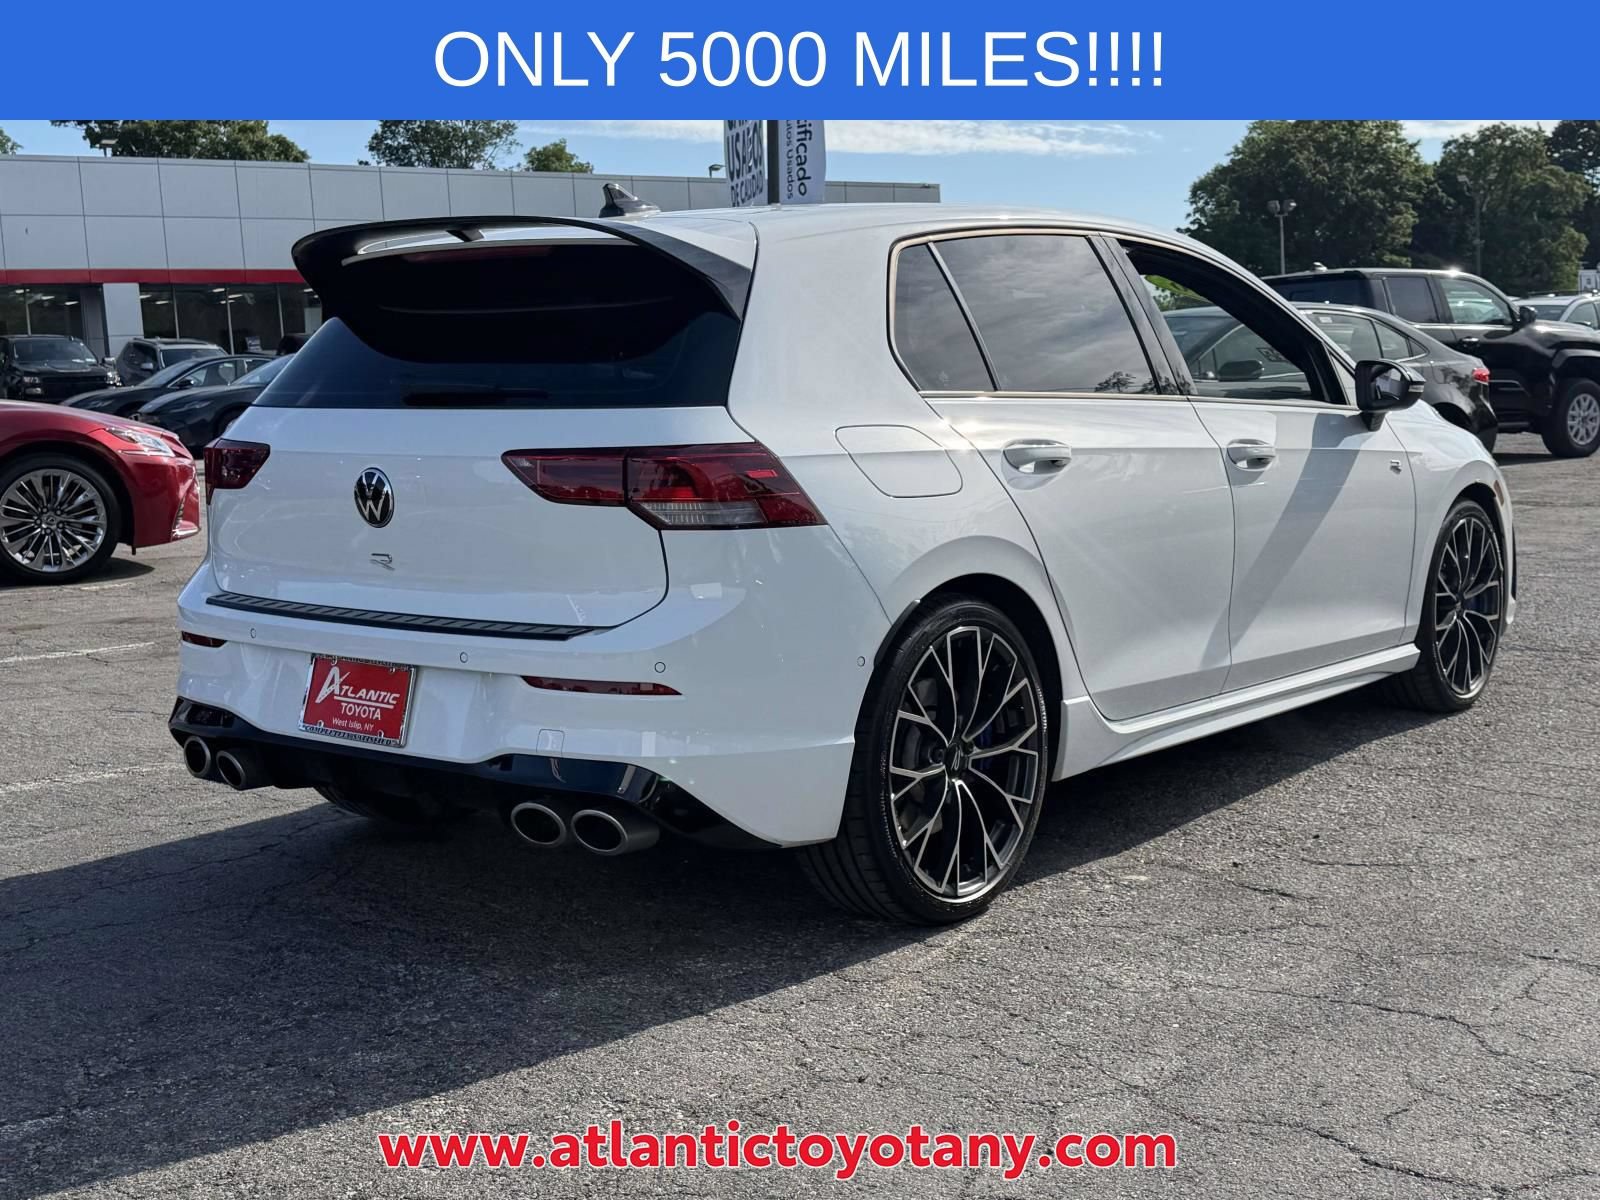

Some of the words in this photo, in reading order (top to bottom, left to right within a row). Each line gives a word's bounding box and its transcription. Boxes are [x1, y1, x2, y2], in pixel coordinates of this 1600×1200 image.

[315, 666, 400, 704] ATLANTIC
[341, 702, 381, 720] TOYOTA
[332, 717, 348, 727] West
[348, 720, 363, 731] Islip,
[364, 721, 375, 731] NY
